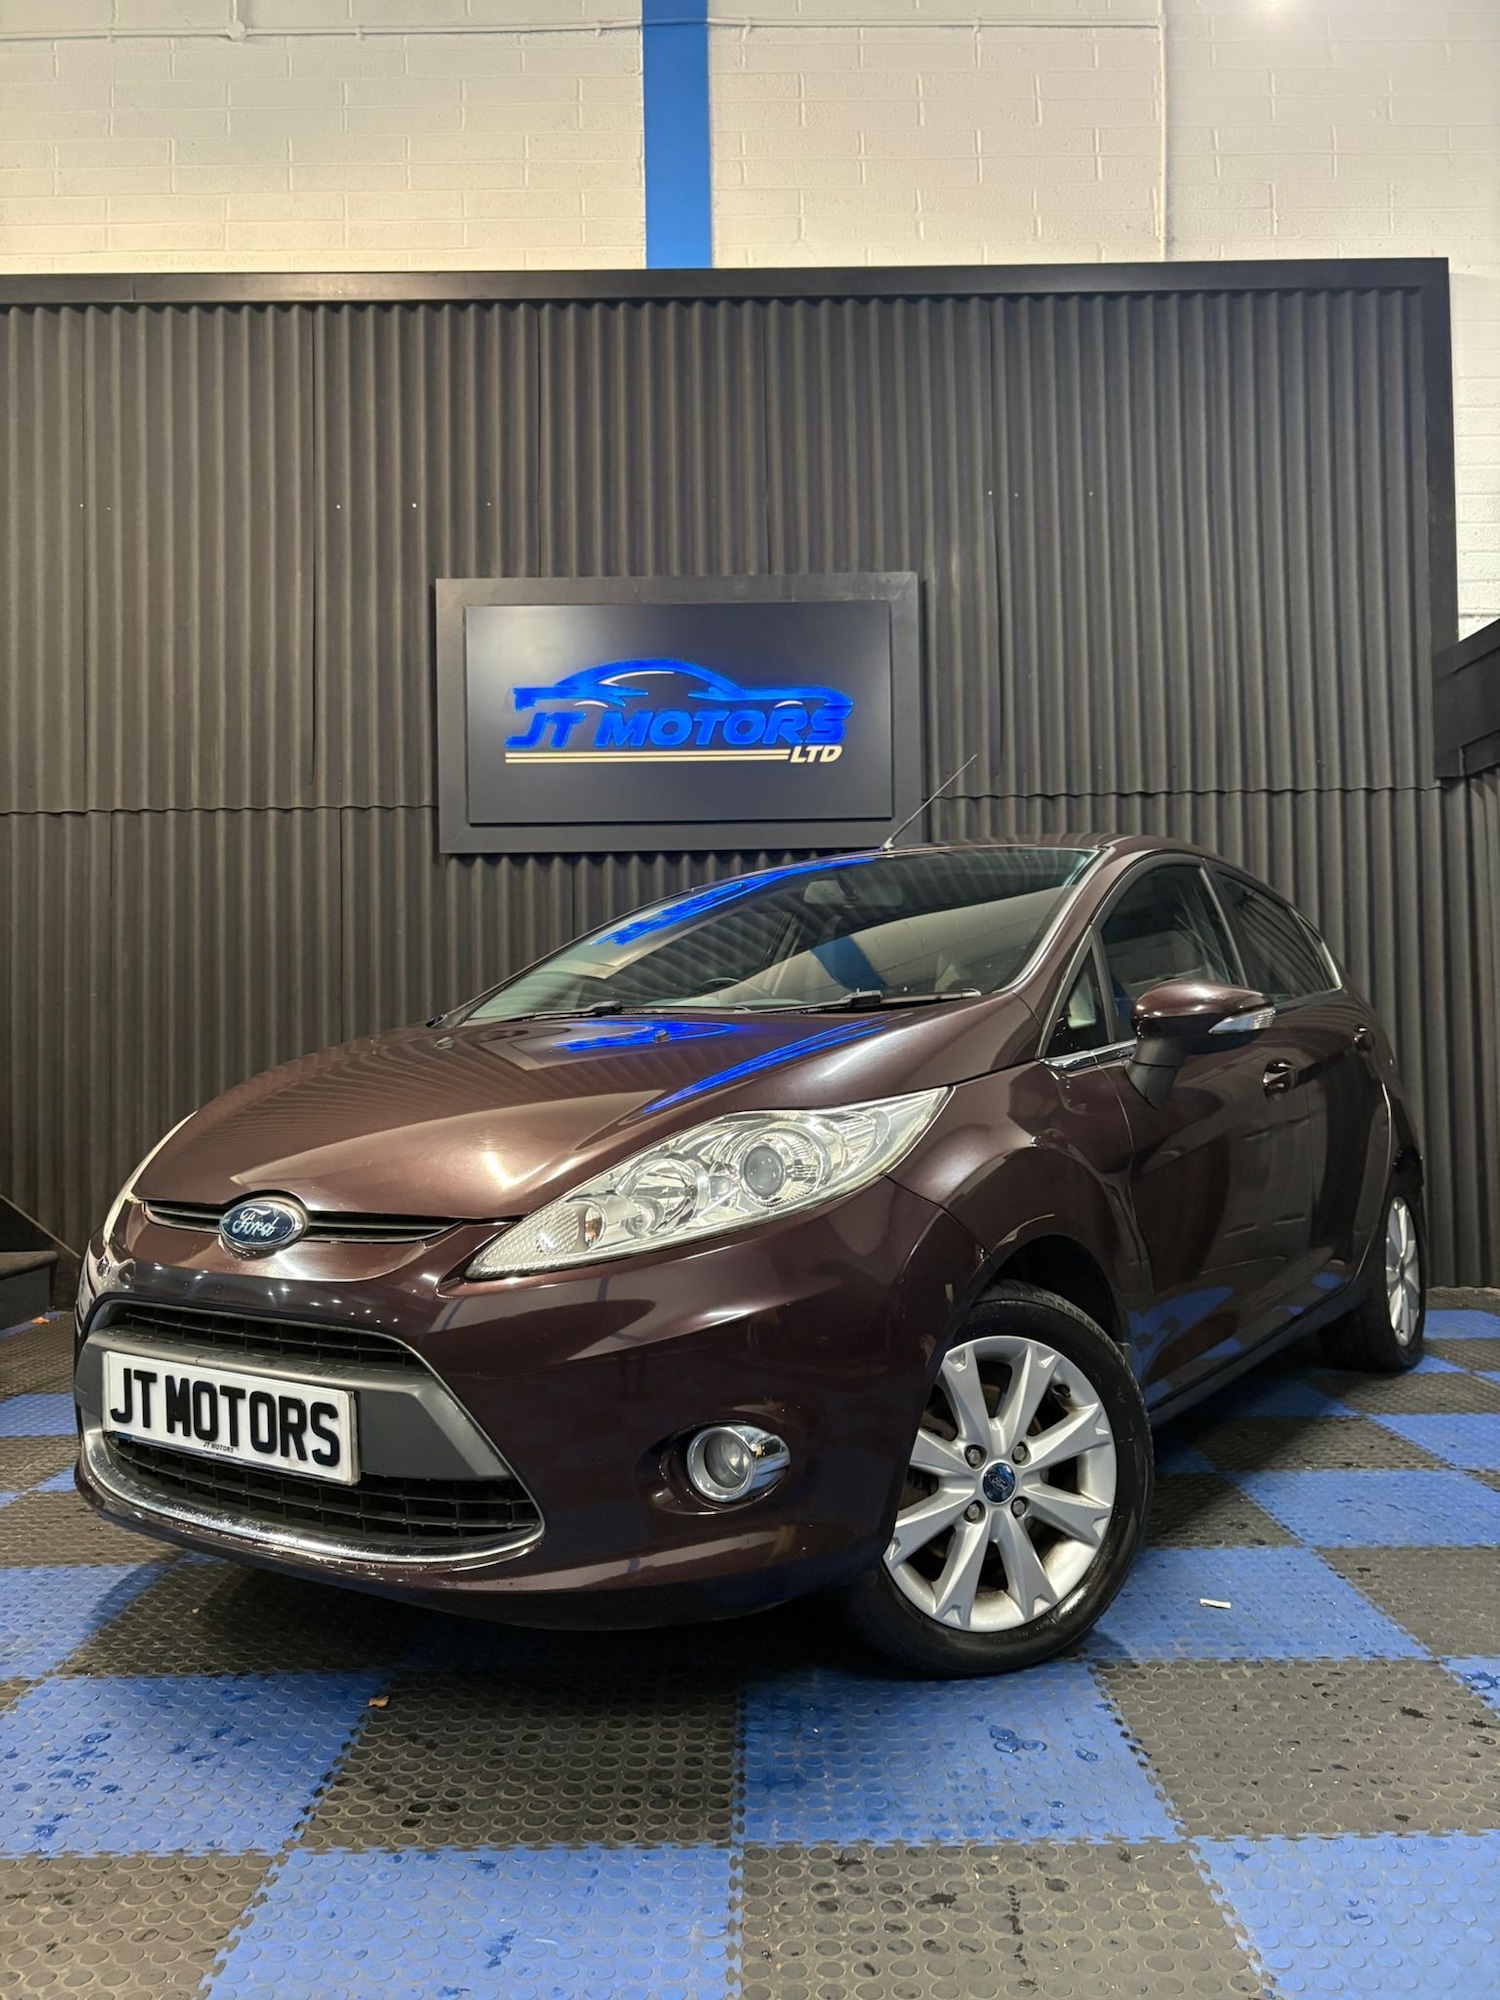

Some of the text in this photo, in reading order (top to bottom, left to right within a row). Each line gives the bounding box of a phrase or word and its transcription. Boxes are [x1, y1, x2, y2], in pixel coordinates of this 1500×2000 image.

[504, 706, 852, 748] JT MOTORS
[789, 745, 843, 764] LTD
[231, 1207, 280, 1237] Ford
[110, 1367, 340, 1467] JT MOTORS
